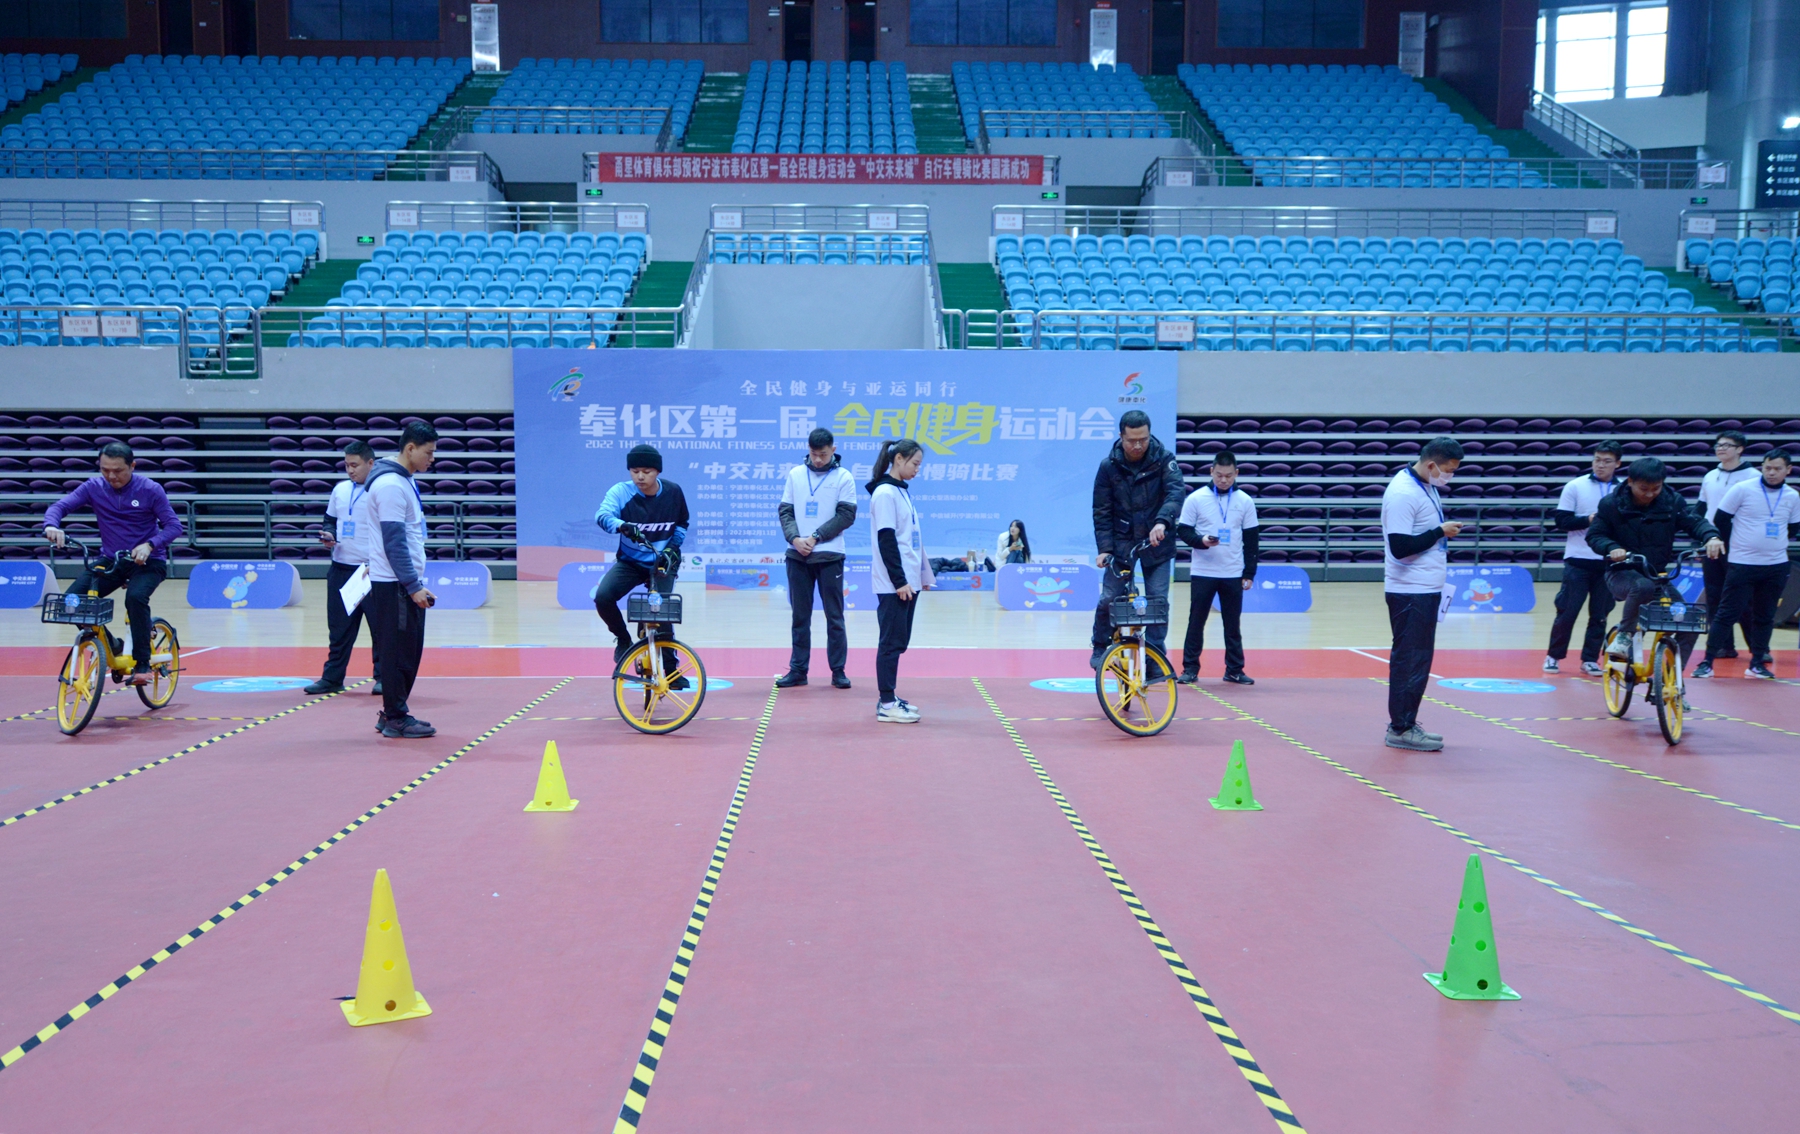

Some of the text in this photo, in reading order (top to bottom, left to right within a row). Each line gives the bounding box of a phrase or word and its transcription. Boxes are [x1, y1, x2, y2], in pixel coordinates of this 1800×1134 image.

[740, 380, 957, 397] 全民健身与亚运同行
[579, 401, 1115, 456] 奉化区第一届 全民健身运动会
[585, 439, 614, 449] 2022
[667, 441, 723, 450] NATIONAL
[728, 441, 775, 450] FITNESS
[758, 573, 769, 587] 2
[970, 575, 982, 589] 3
